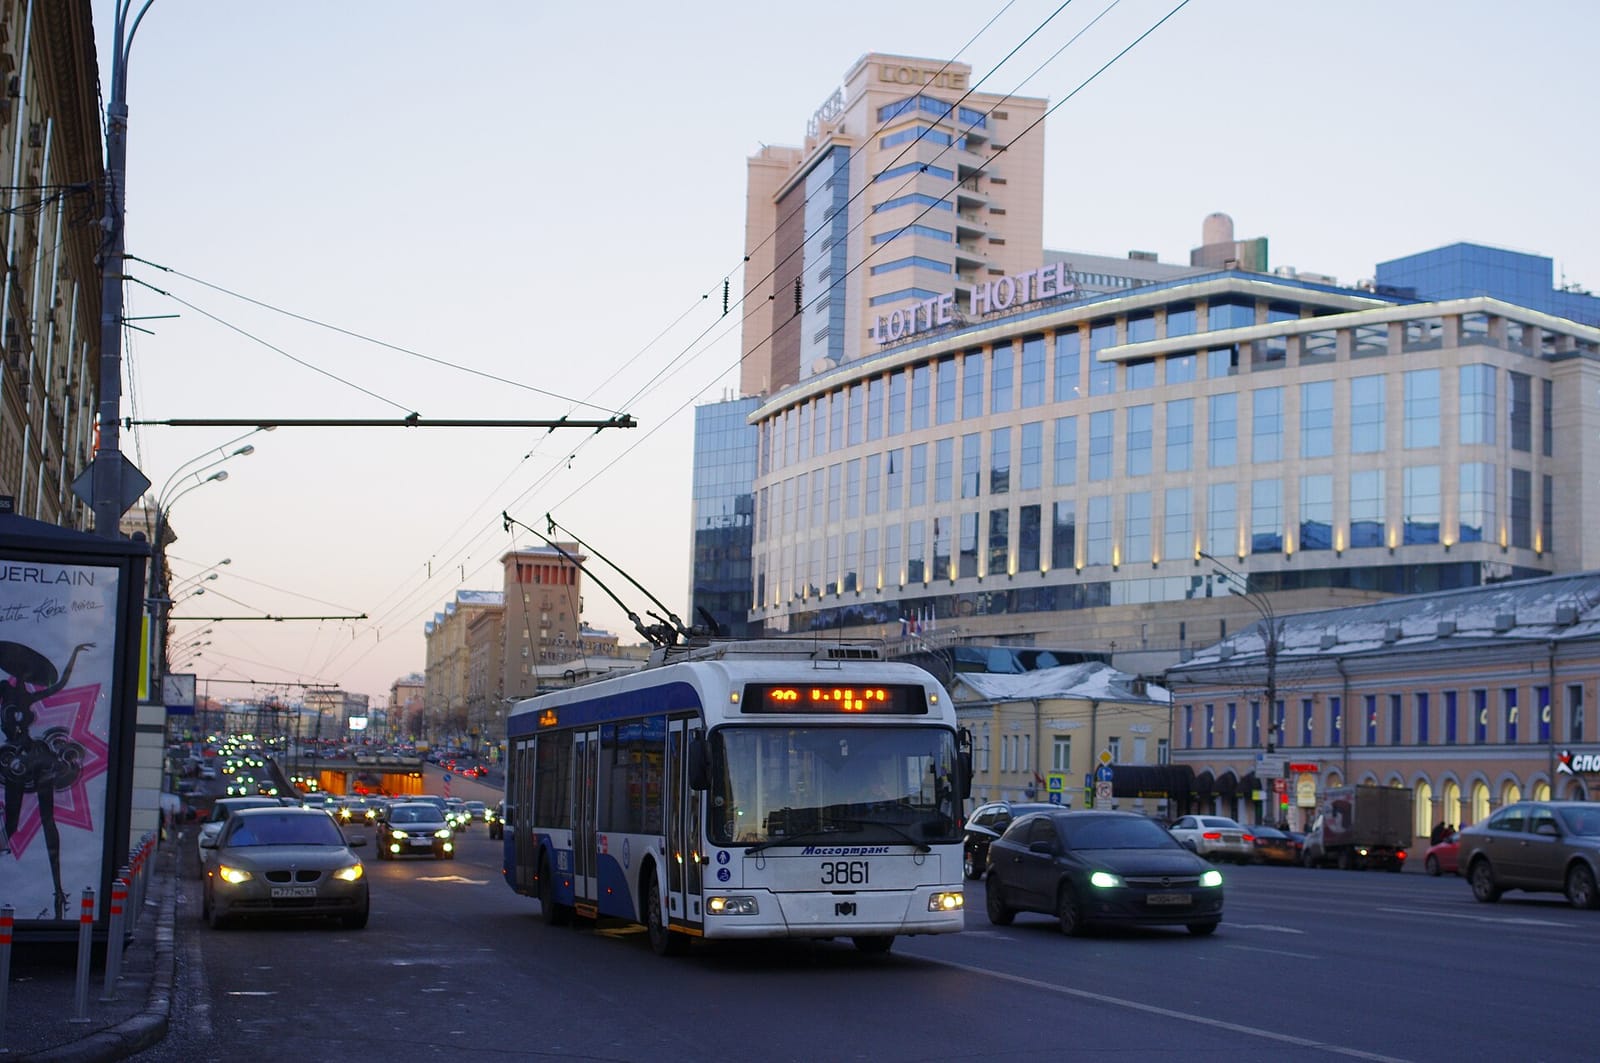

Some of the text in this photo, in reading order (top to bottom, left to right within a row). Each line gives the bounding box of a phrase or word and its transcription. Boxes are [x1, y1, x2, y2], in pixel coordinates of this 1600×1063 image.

[879, 64, 966, 90] LOTTE
[873, 261, 1075, 344] LOTTE HOTEL
[801, 845, 890, 856] Мосгортранс
[821, 861, 869, 884] 3861
